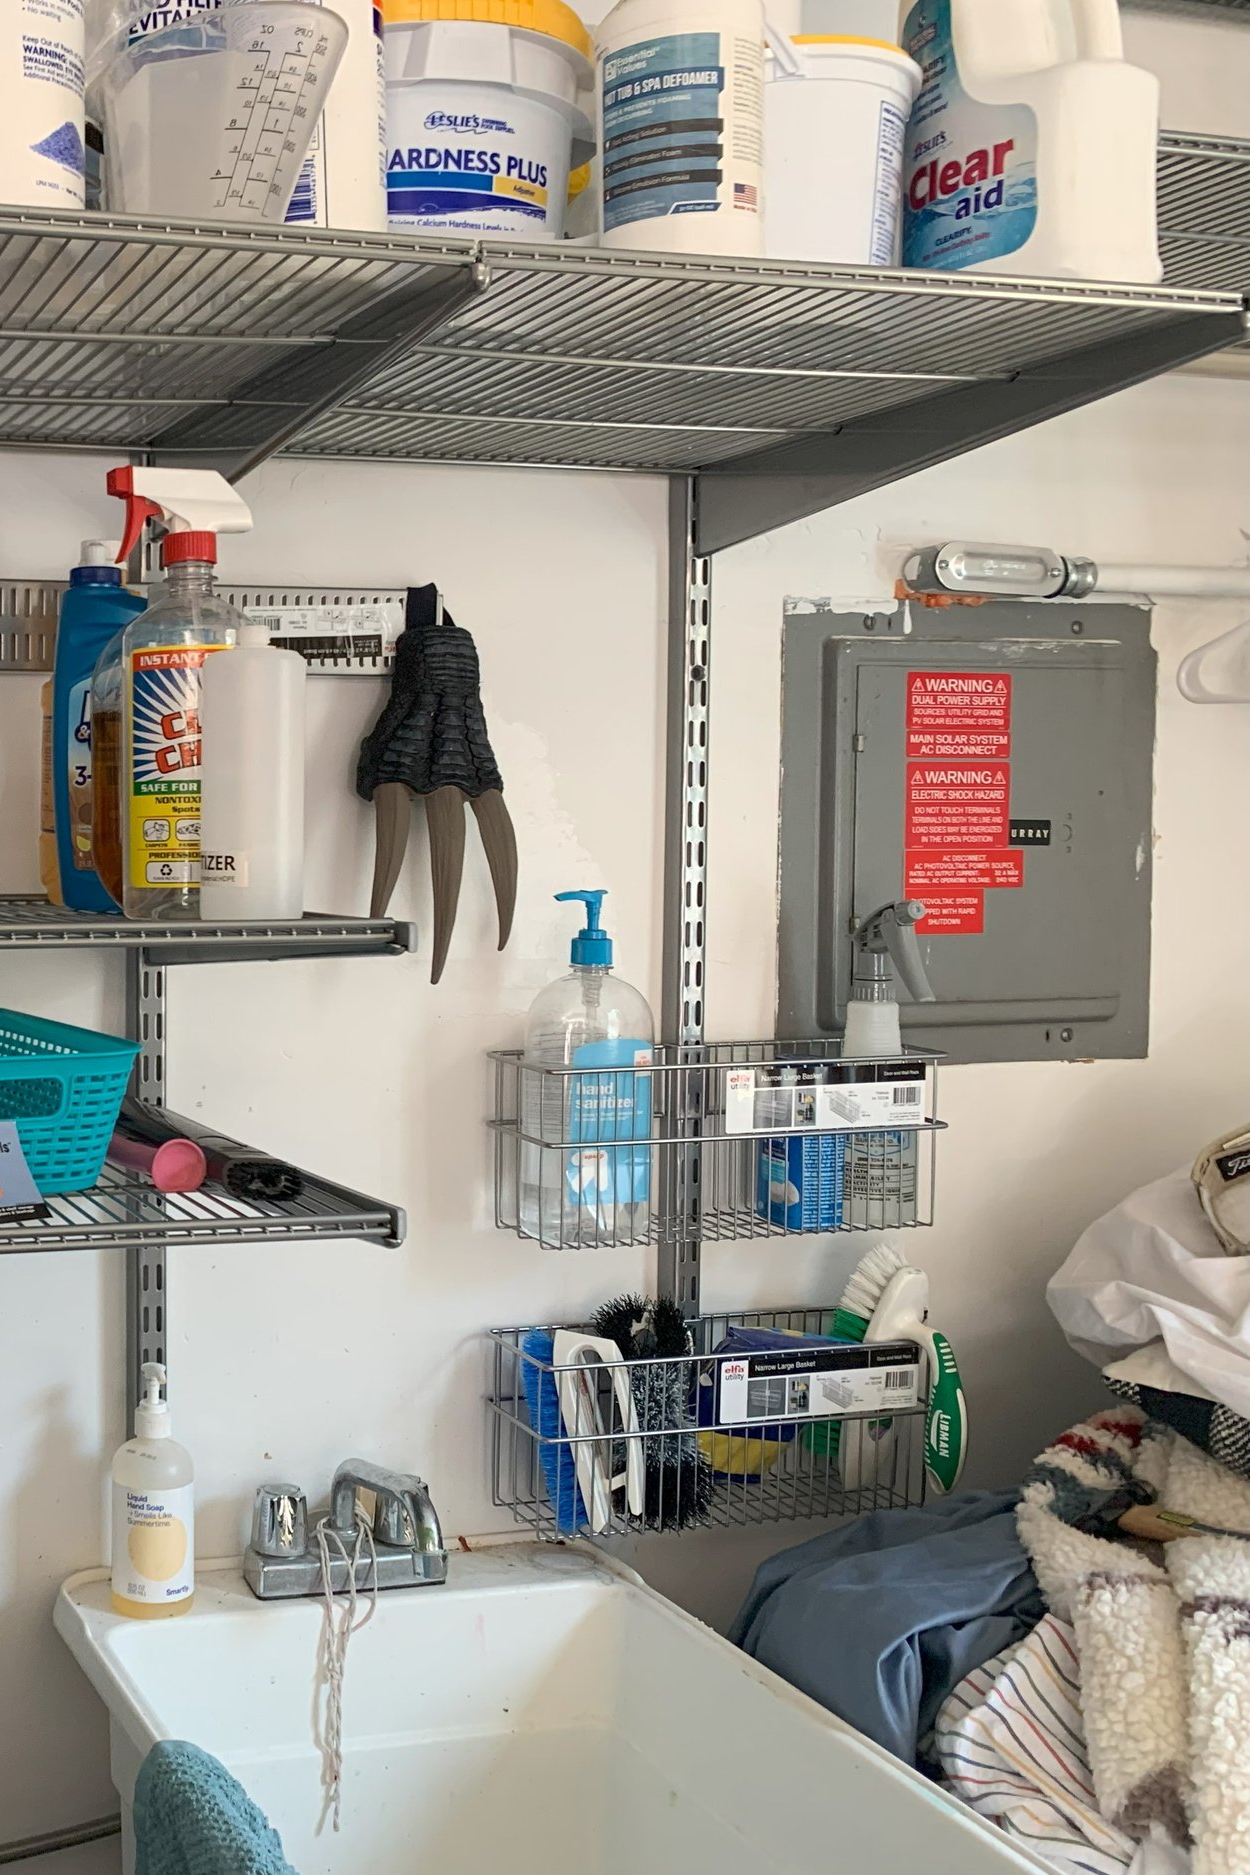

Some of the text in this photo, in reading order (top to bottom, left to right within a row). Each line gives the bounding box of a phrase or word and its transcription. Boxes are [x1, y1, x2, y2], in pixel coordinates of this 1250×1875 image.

[617, 85, 633, 101] TUB
[642, 77, 662, 93] SPA
[663, 71, 718, 91] DEFOAMER
[388, 148, 547, 187] ARDNESS PLUS
[910, 138, 1014, 211] Clear
[955, 180, 1004, 220] aid
[417, 218, 447, 227] Calcium
[449, 220, 481, 230] Hardness
[140, 652, 201, 667] INSTANT
[925, 679, 993, 693] WARNING
[912, 696, 1006, 706] DUAL POWER SUPPLY
[910, 735, 1008, 745] MAIN SOLAR SYSTEM
[920, 745, 997, 755] AC DISCONNECT
[925, 771, 992, 784] WARNING
[141, 782, 197, 793] SAFE FOR
[155, 796, 201, 804] NONTOXI
[912, 790, 1005, 800] ELECTRIC SHOCK HAZARD
[1011, 829, 1049, 838] URRAY
[761, 1071, 823, 1083] Narrow Large Basket
[576, 1082, 614, 1095] hand
[575, 1096, 637, 1110] sanitizer
[724, 1364, 745, 1374] elfa
[755, 1360, 816, 1372] Narrow Large Basket
[725, 1372, 745, 1382] utility
[938, 1409, 951, 1458] LIBMAN
[127, 1493, 147, 1502] Liquid
[127, 1502, 164, 1512] Hand Soap
[166, 1585, 189, 1597] Smartly
